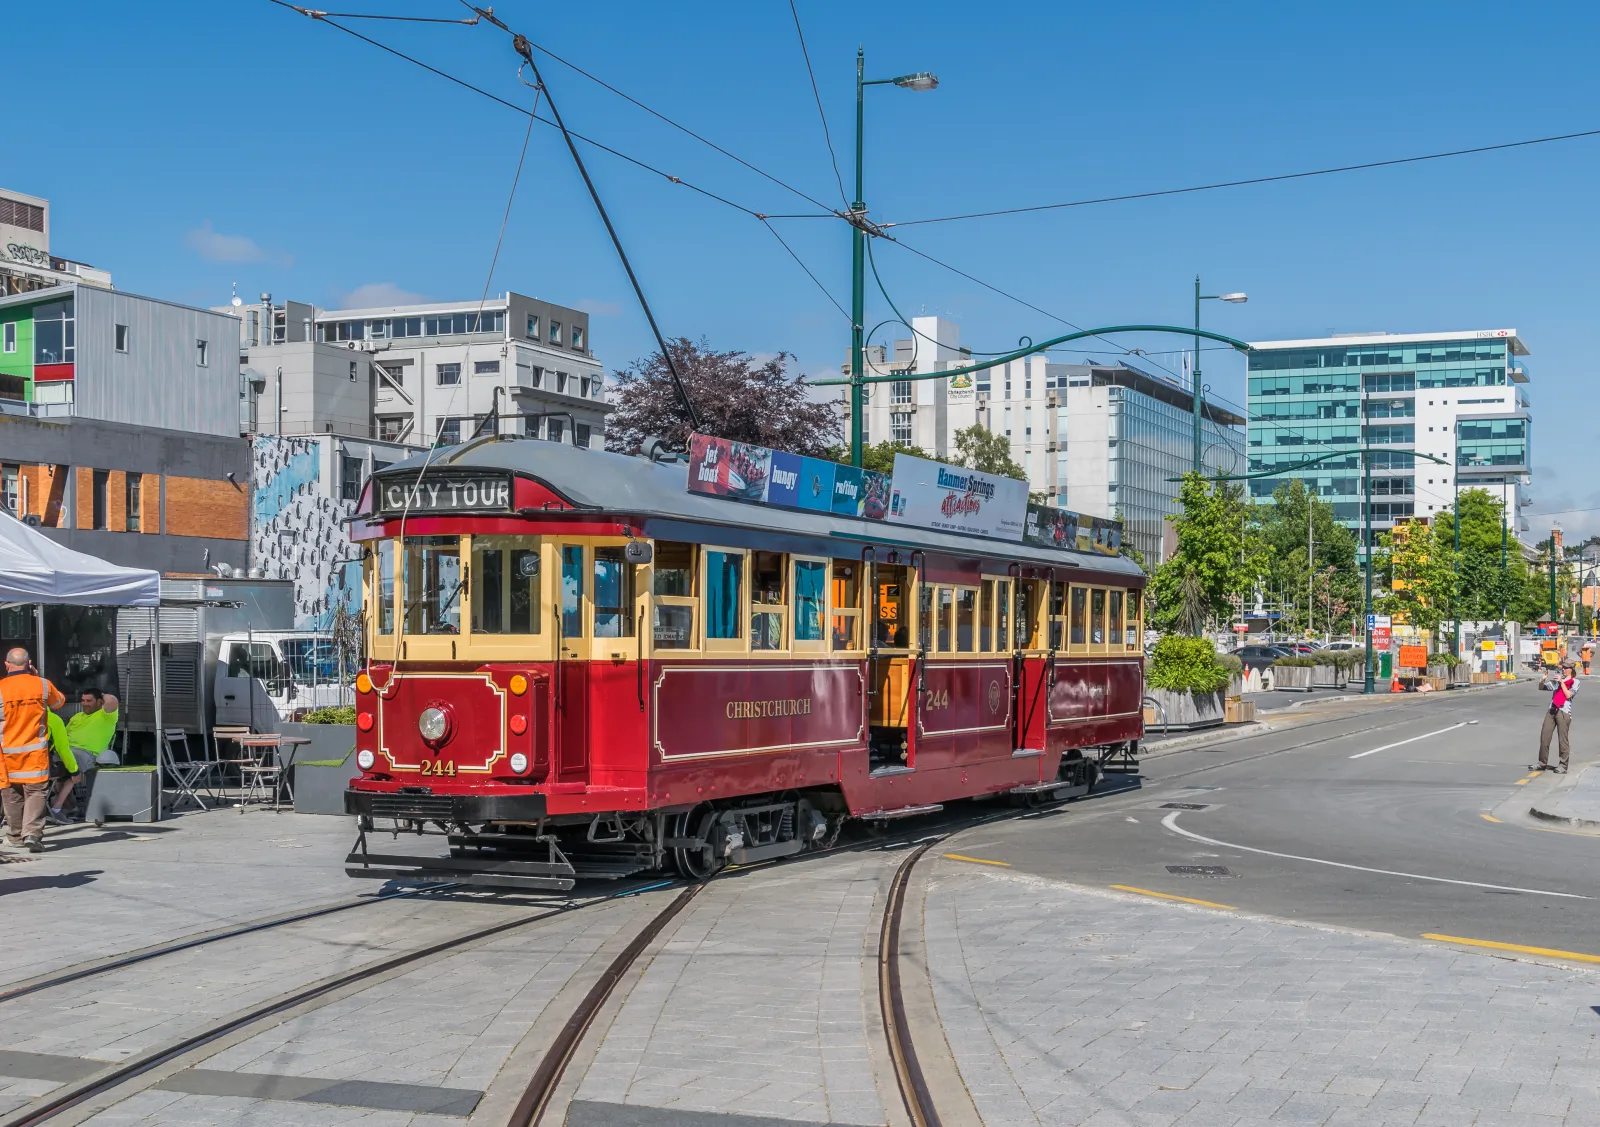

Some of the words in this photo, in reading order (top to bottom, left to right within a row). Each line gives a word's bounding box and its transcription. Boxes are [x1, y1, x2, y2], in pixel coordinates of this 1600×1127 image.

[703, 444, 719, 466] jet
[698, 462, 719, 483] boat
[771, 465, 798, 490] bungy
[387, 483, 440, 508] CITY
[446, 481, 509, 507] TOUR
[835, 480, 859, 500] rafting
[937, 467, 968, 491] Hanmer
[967, 474, 996, 503] Springs
[1372, 628, 1386, 636] ublic
[1372, 637, 1389, 645] arking
[726, 698, 811, 719] CHRISTCHURCH
[925, 689, 949, 711] 244
[421, 759, 457, 777] 244
